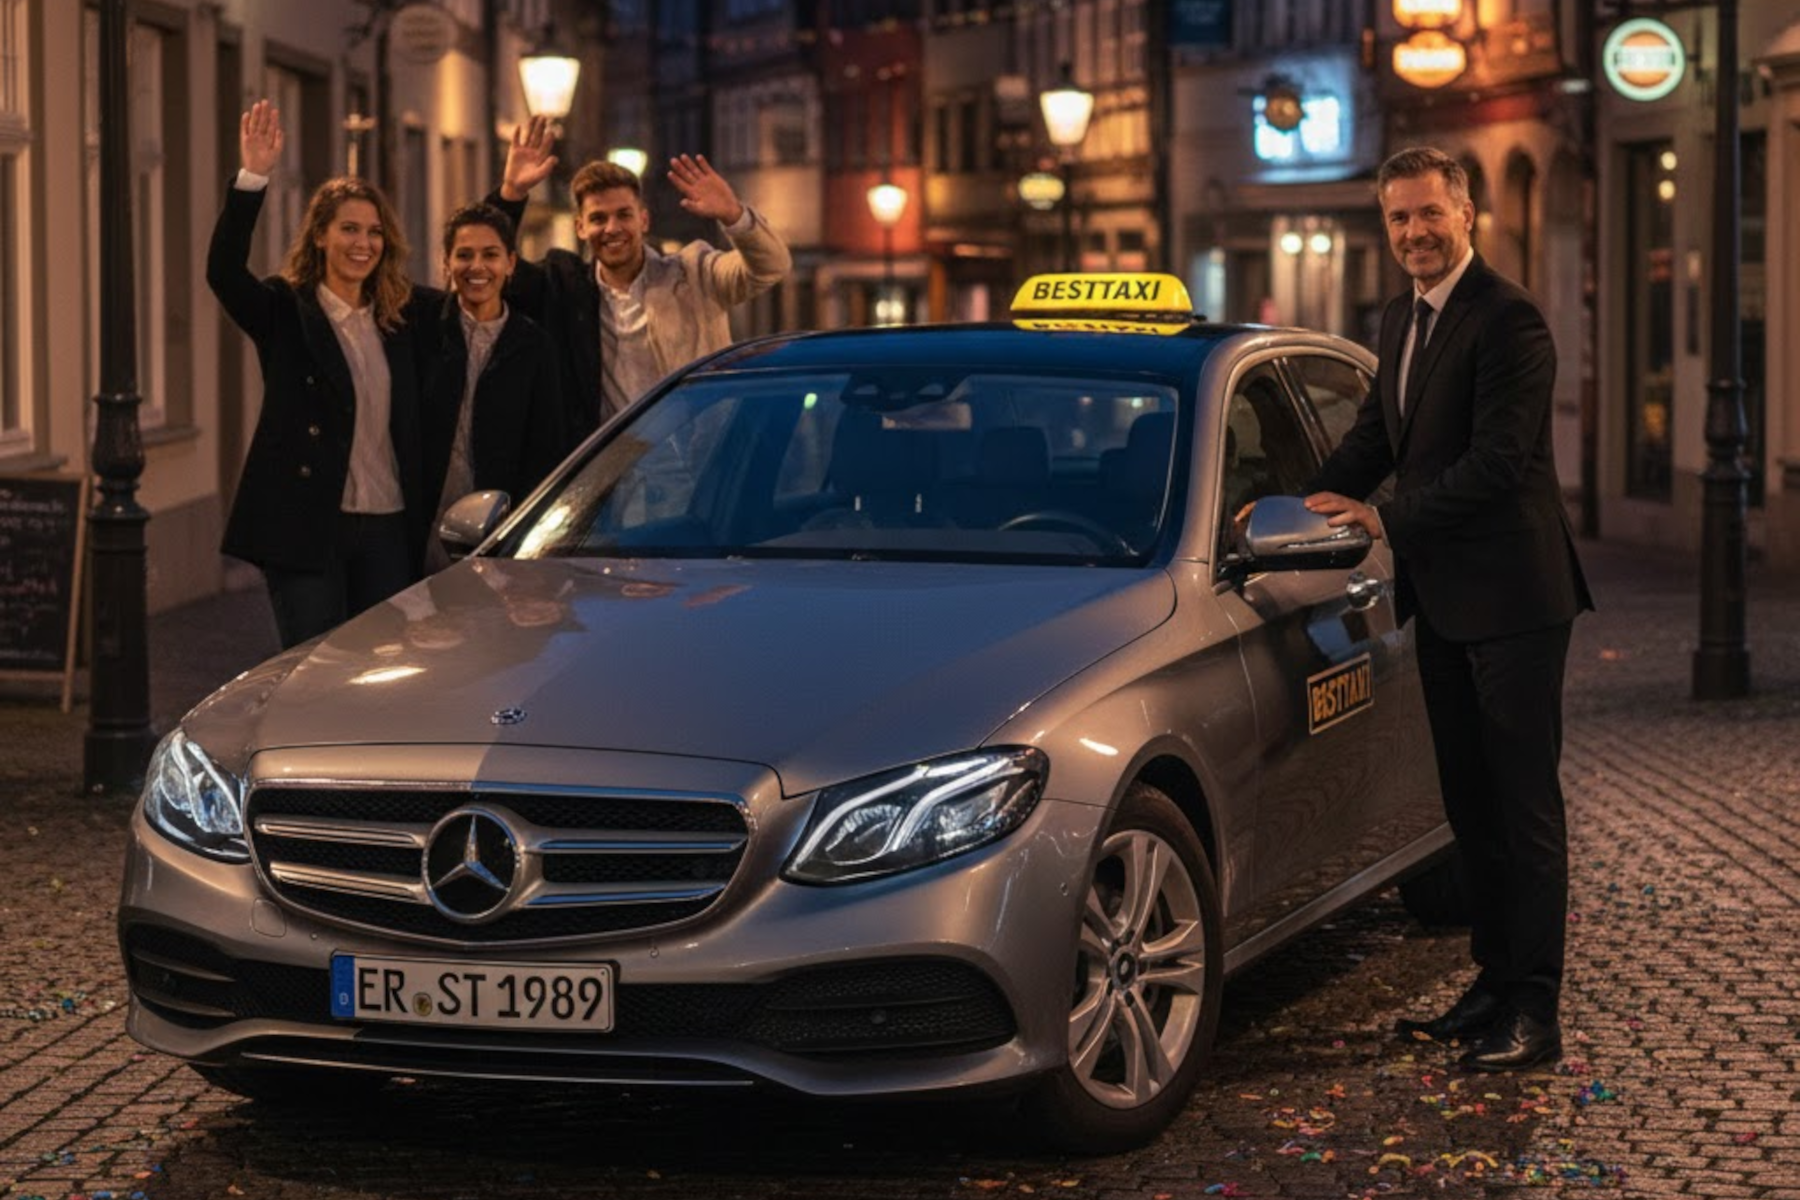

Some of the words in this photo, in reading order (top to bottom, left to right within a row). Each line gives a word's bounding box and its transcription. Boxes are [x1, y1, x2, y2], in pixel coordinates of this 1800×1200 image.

[1032, 280, 1161, 301] BESTTAXI
[358, 967, 408, 1013] ER
[437, 972, 487, 1017] ST
[497, 974, 604, 1021] 1989
